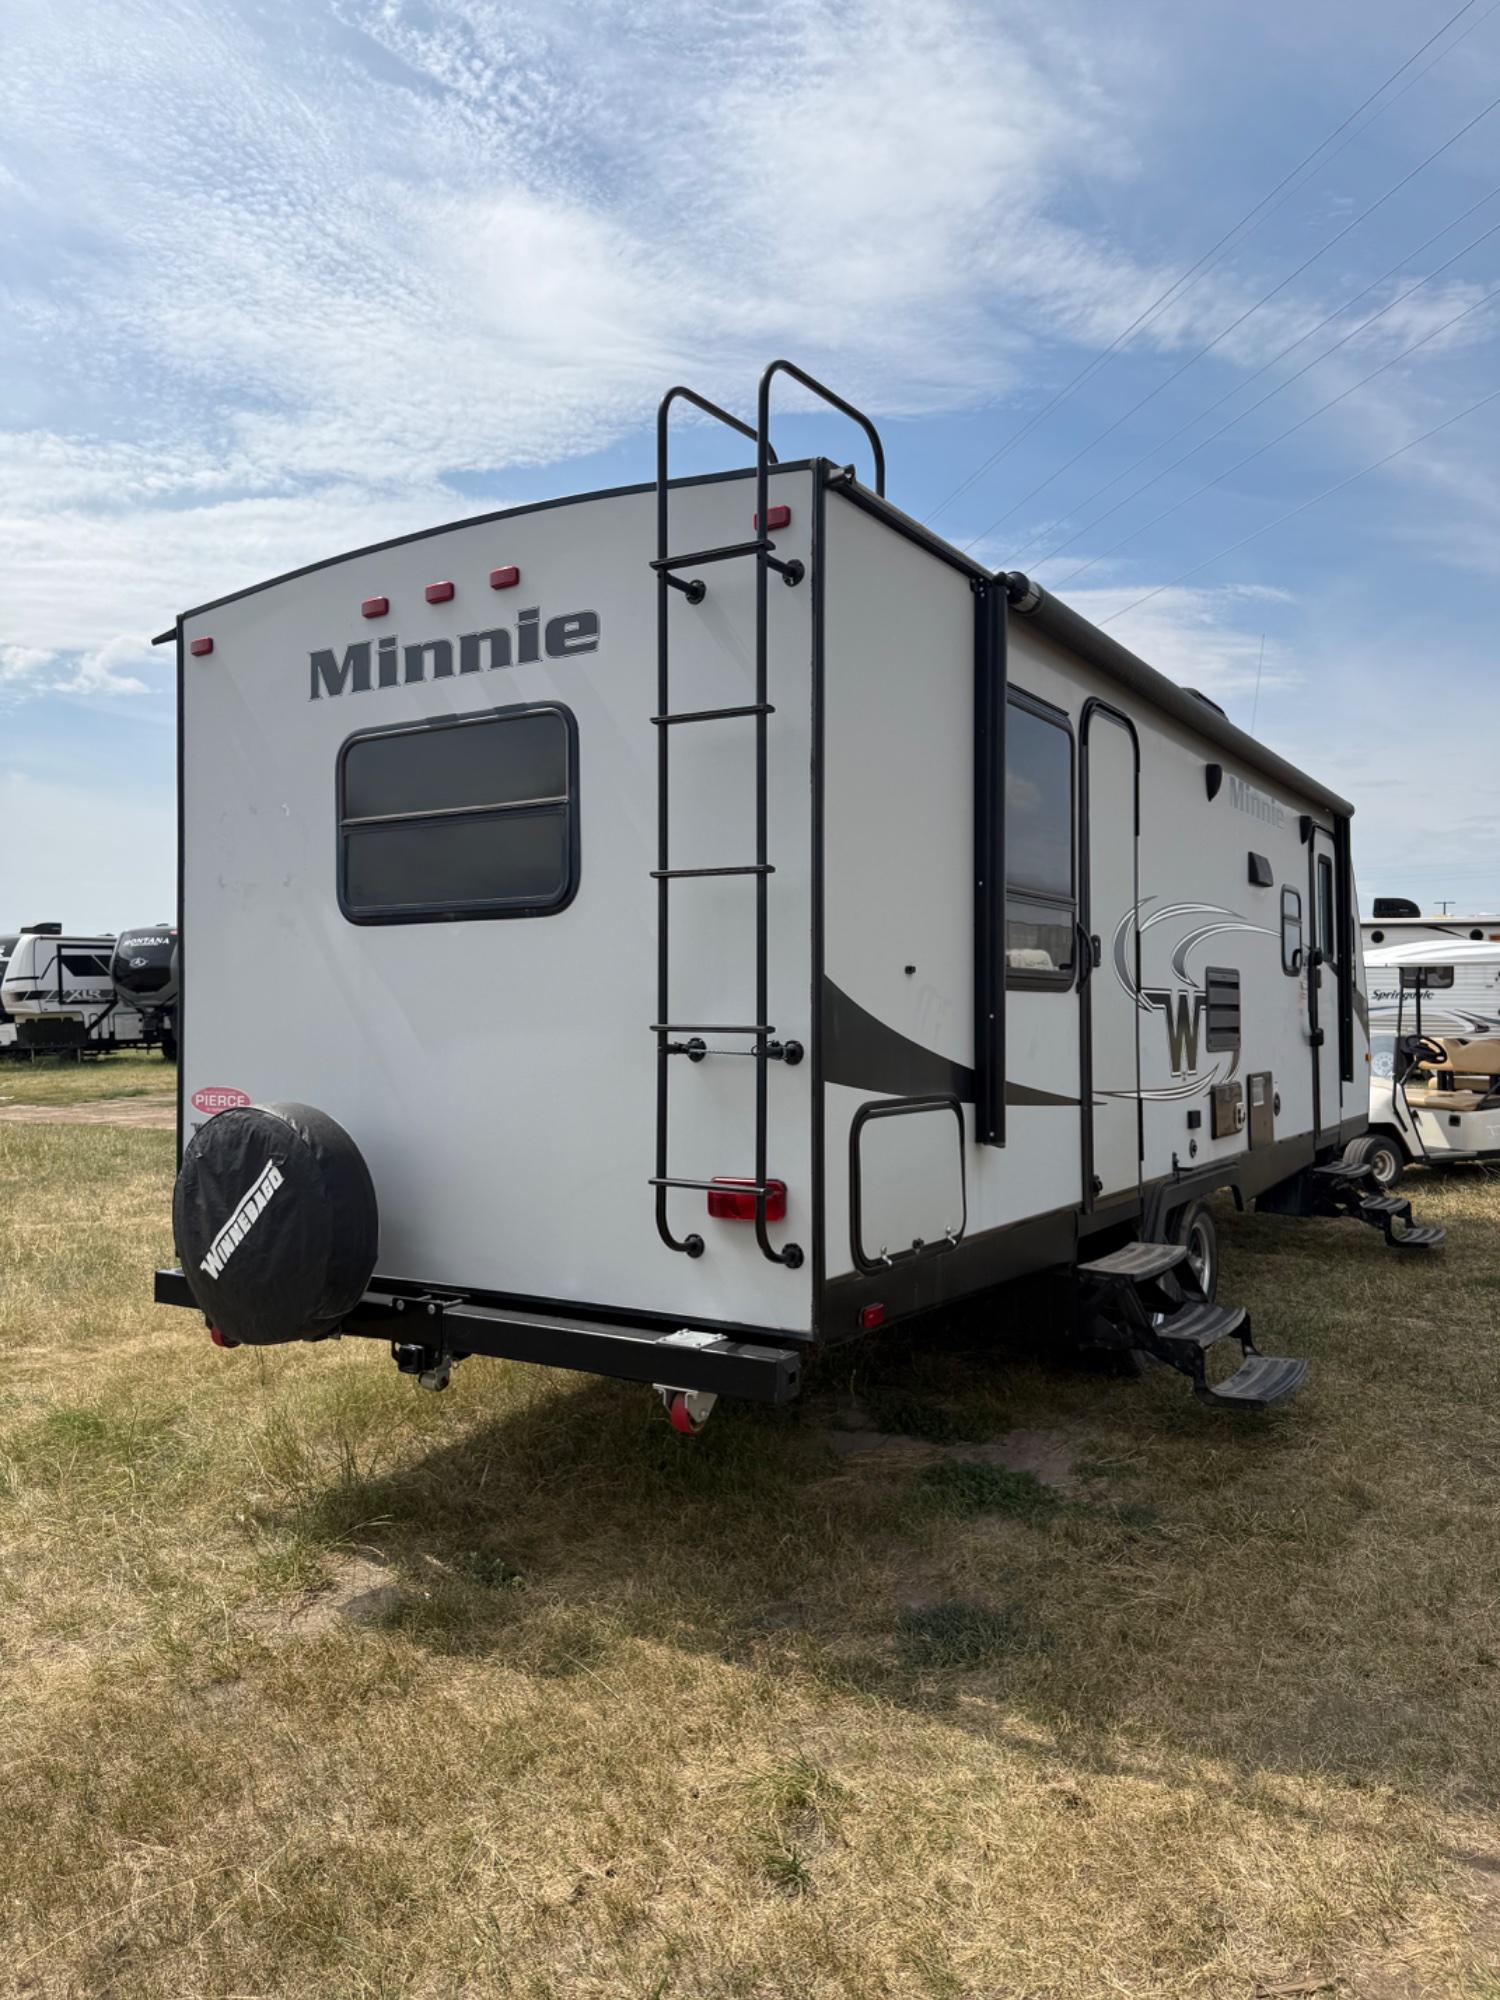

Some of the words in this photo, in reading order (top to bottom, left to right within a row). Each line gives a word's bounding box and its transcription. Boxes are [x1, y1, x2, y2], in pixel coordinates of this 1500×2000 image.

[308, 607, 600, 701] Minnie
[1229, 775, 1286, 829] Minnie
[195, 1094, 246, 1107] PIERCE
